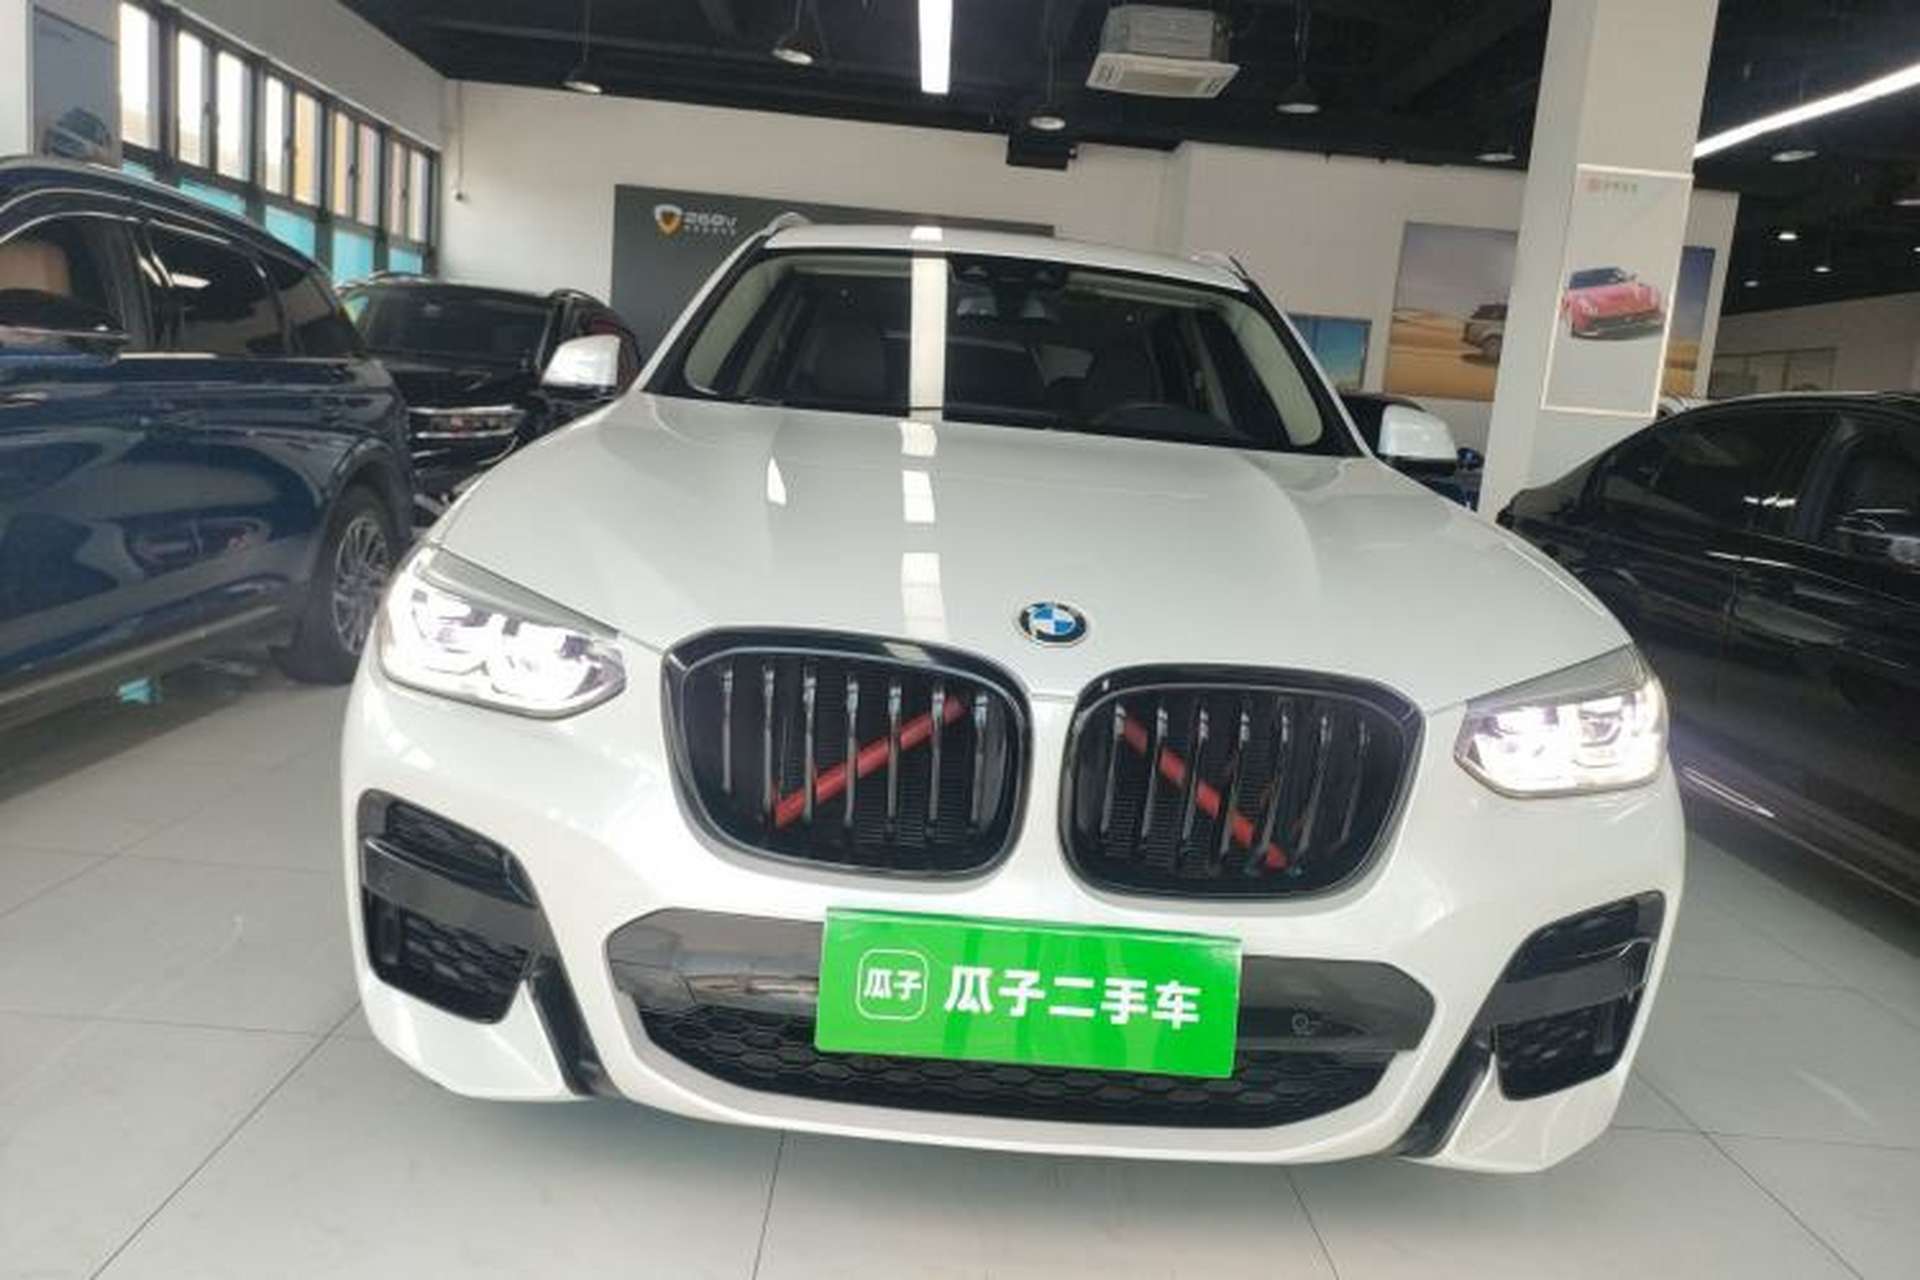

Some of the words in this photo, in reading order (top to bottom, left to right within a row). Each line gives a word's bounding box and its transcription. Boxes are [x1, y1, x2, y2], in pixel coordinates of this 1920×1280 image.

[863, 968, 922, 1000] 瓜子
[944, 965, 1200, 1030] 瓜子二手车
